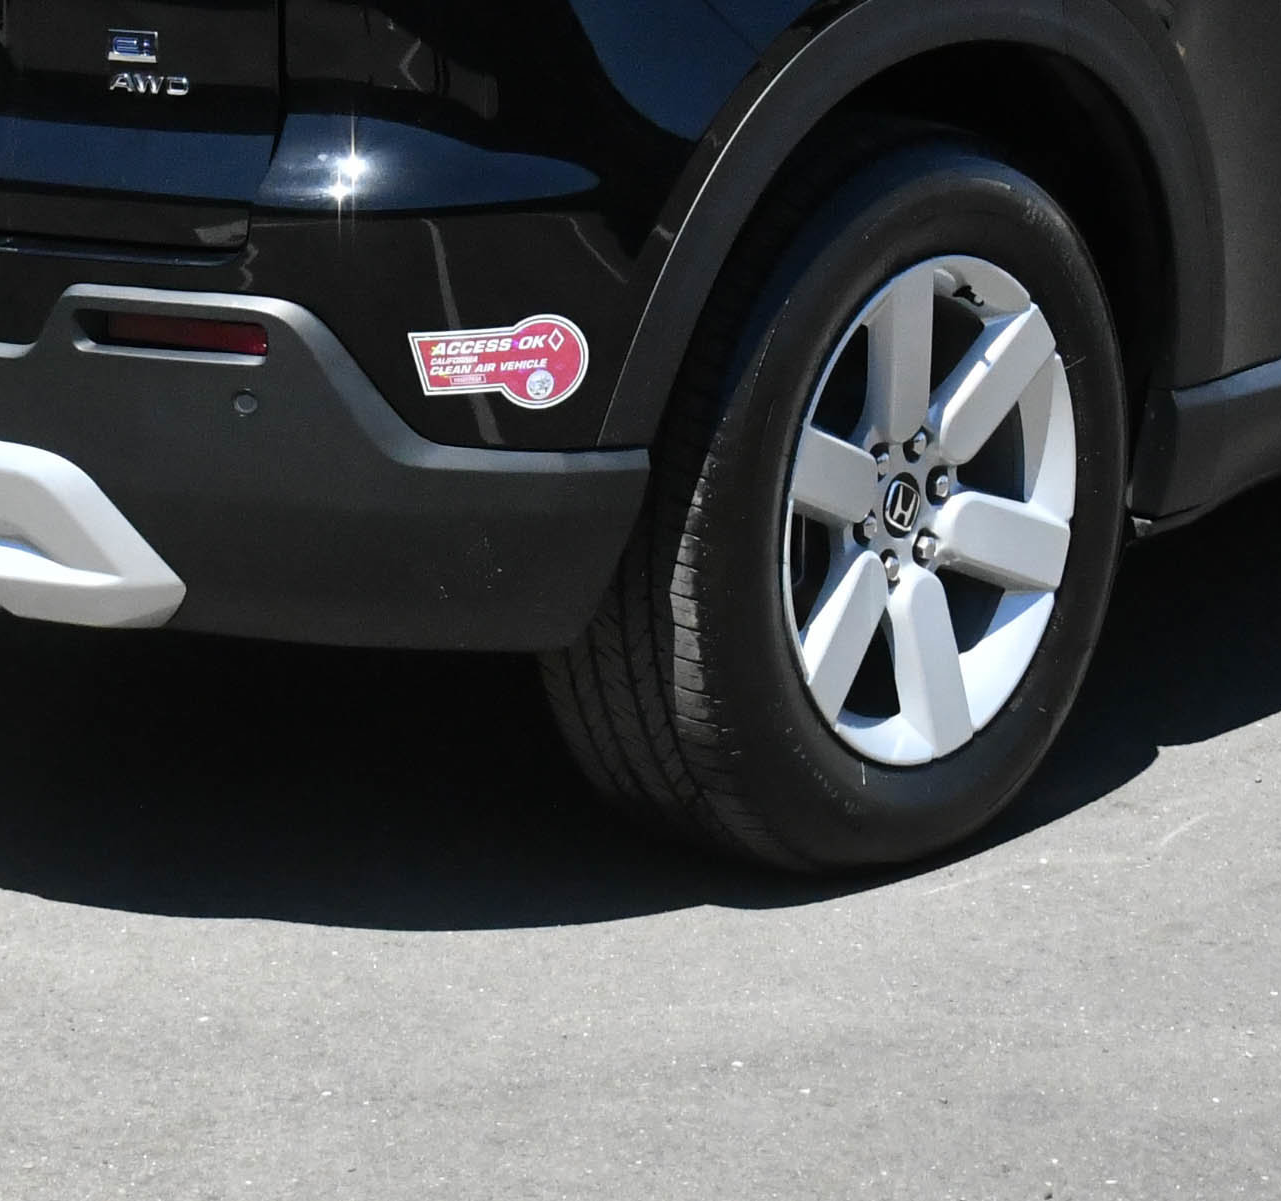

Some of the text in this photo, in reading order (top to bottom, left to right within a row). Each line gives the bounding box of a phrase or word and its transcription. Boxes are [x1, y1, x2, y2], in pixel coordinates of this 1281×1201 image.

[110, 72, 190, 96] AWD
[431, 335, 548, 357] ACCESS OK
[430, 358, 548, 376] CLEAN AIR VEHICLE
